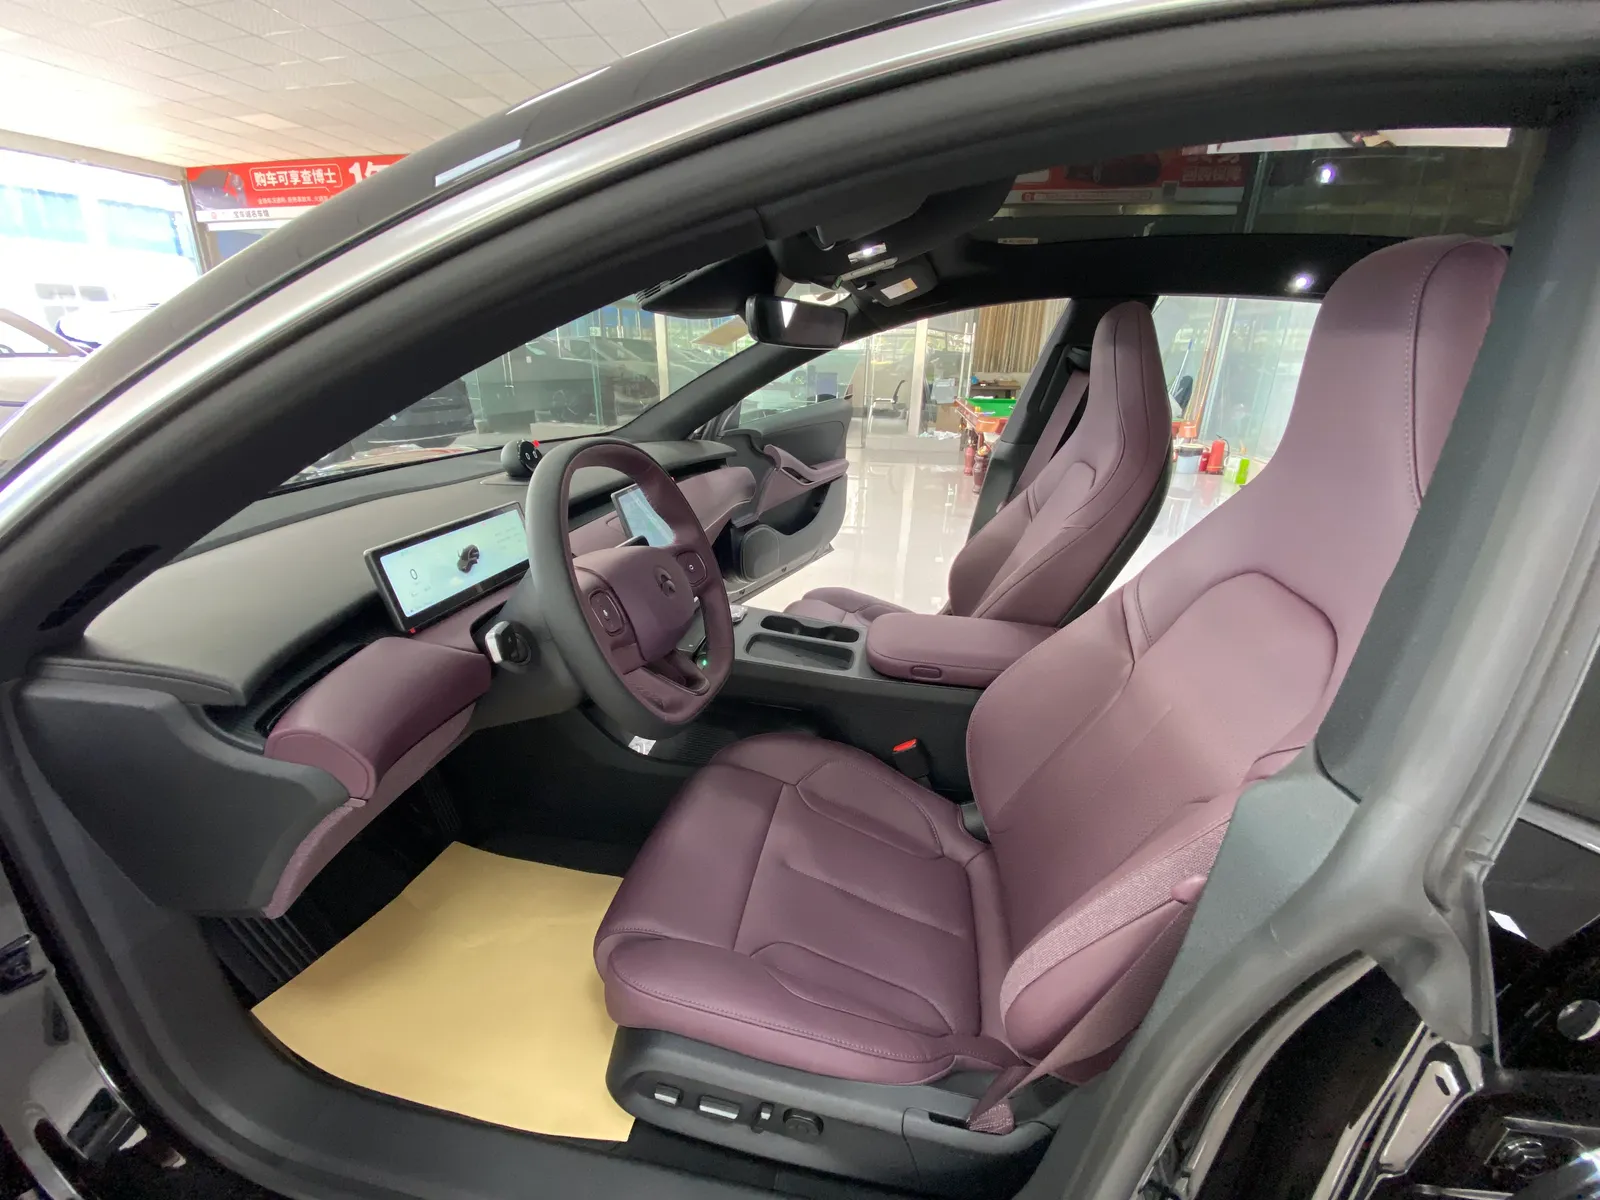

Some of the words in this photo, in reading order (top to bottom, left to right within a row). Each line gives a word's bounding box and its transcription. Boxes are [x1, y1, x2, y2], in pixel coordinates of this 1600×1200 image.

[253, 168, 337, 187] 购车可享查博士
[410, 569, 418, 580] 0
